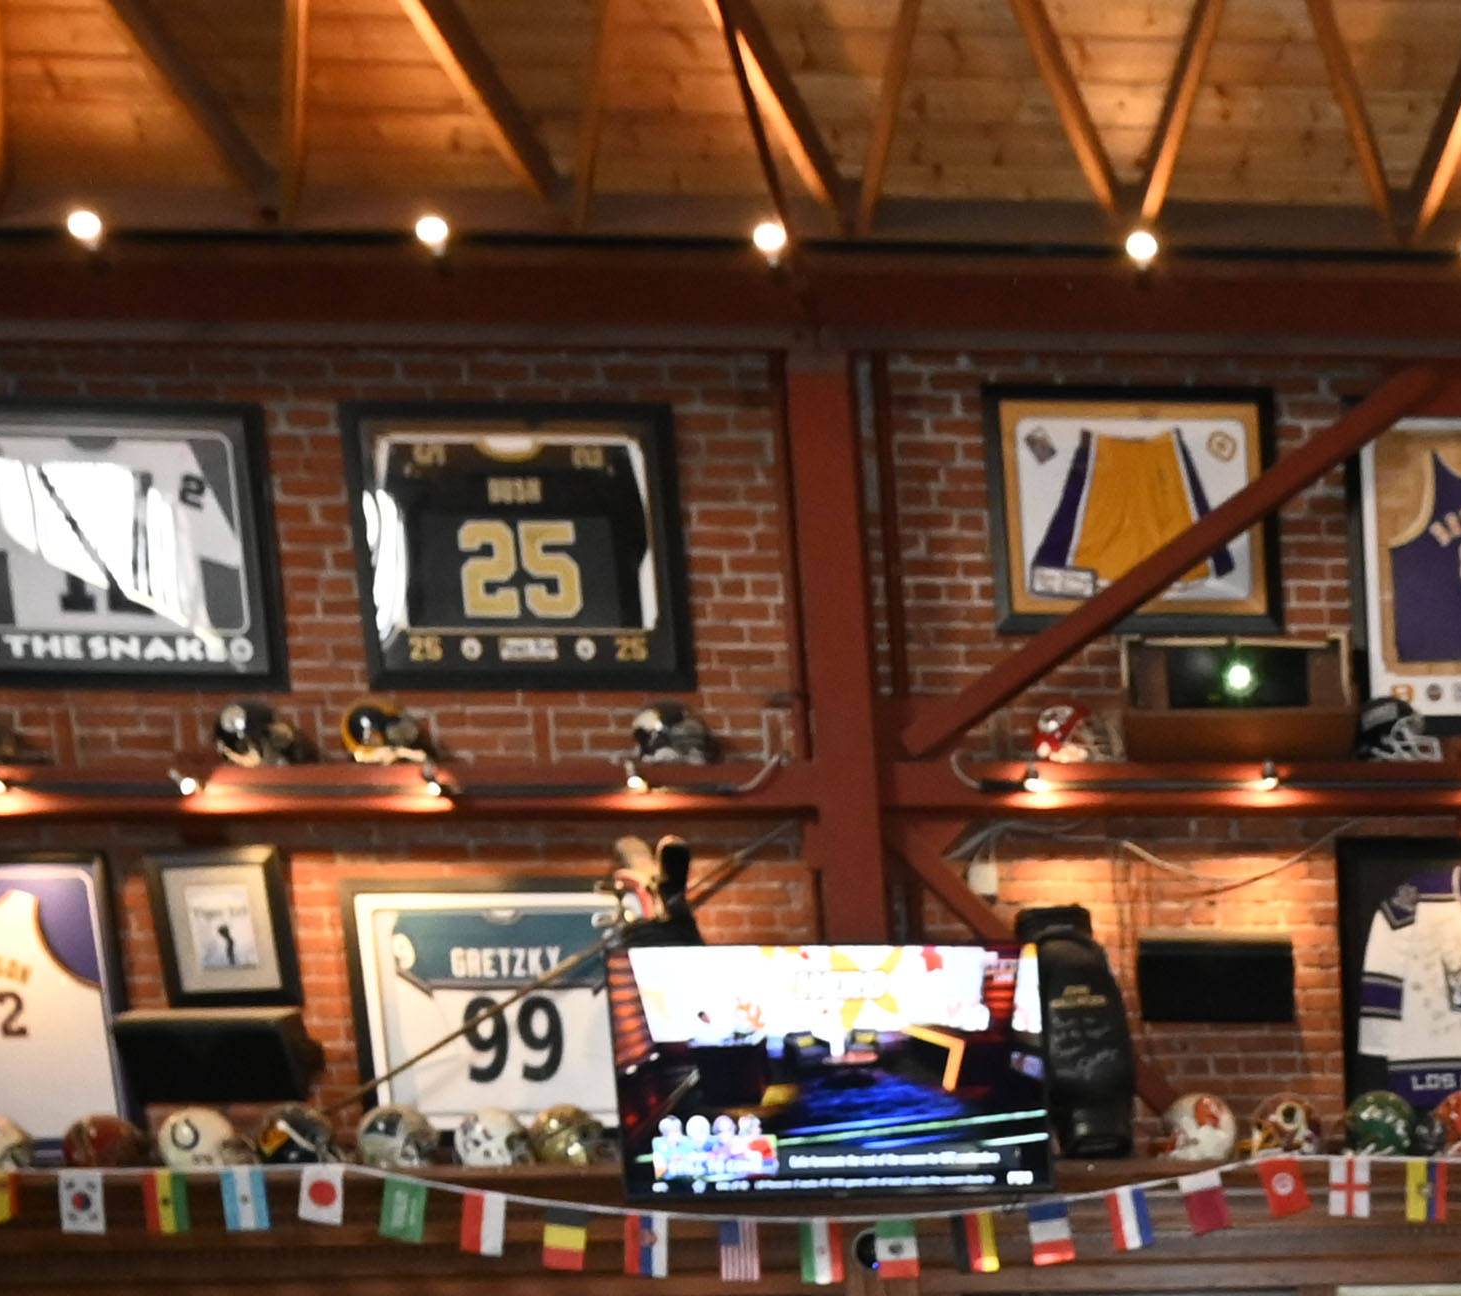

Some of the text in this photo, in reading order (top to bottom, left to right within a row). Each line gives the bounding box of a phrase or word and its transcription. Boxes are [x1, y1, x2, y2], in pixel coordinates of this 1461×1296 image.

[457, 519, 585, 619] 25
[1, 633, 84, 660] THE
[449, 944, 563, 979] GRETZKY
[465, 997, 567, 1084] 99
